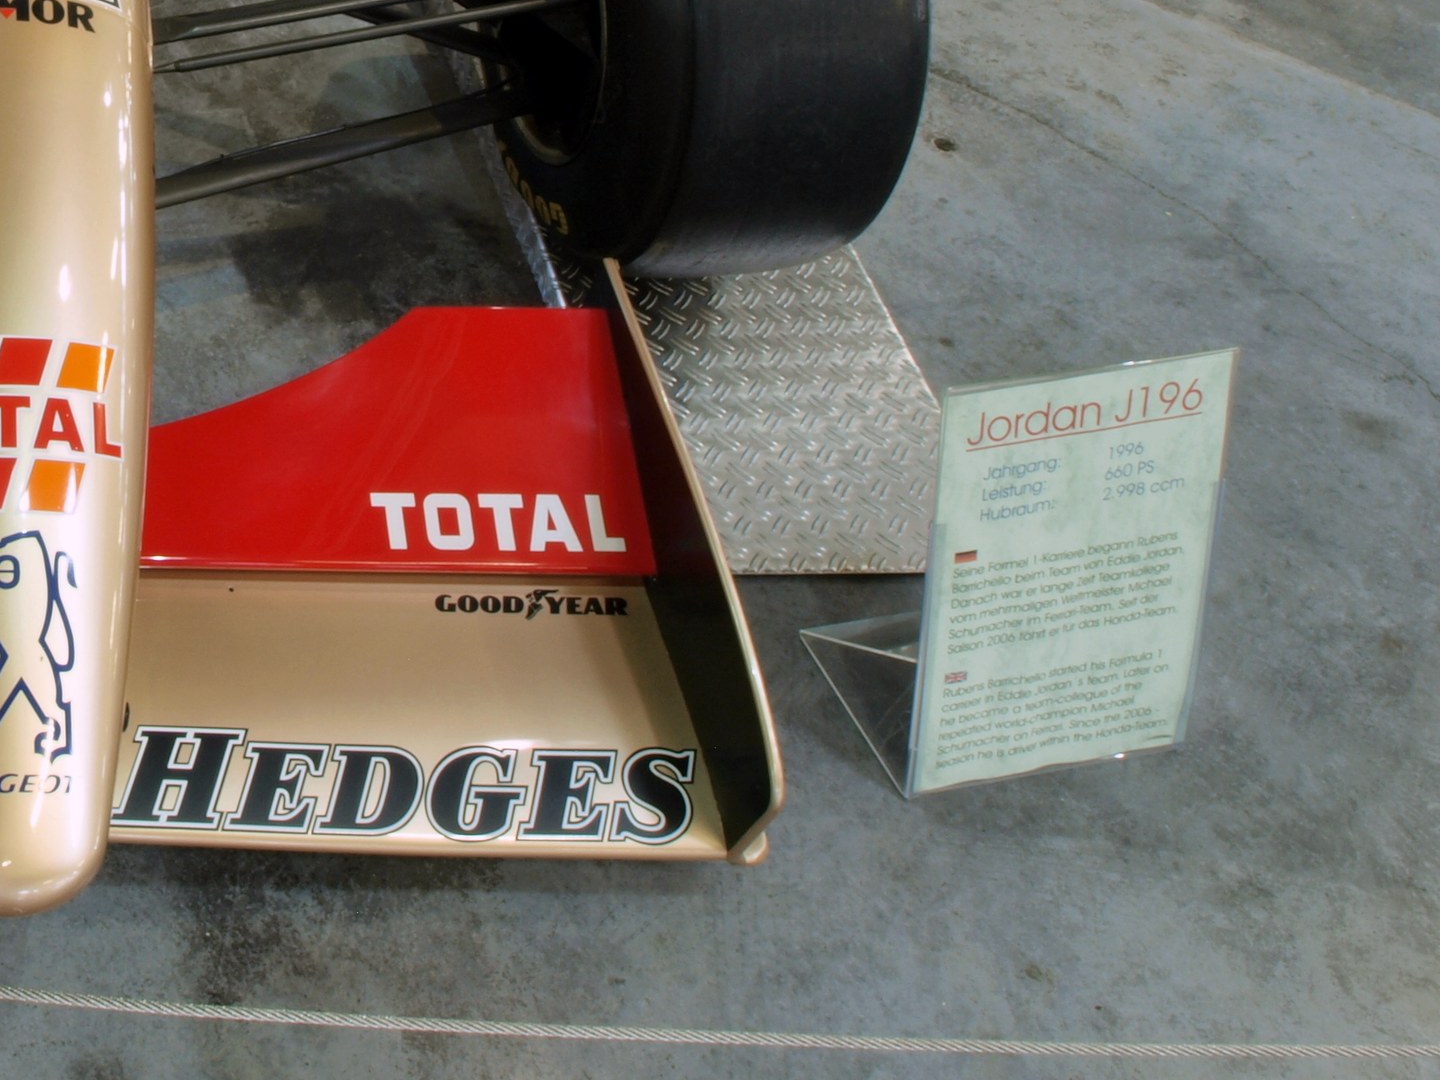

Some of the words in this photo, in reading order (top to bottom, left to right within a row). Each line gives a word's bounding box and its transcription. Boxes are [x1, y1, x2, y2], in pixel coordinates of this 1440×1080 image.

[966, 399, 1103, 445] Jordan
[1114, 377, 1205, 422] J196
[980, 478, 1047, 503] Leistung:
[1104, 463, 1133, 480] 660
[1136, 459, 1155, 474] PS
[982, 455, 1062, 484] Jahrgang:
[1108, 440, 1145, 459] 1996
[369, 492, 627, 553] TOTAL
[979, 497, 1055, 522] Hubraum:
[1102, 481, 1146, 501] 2.998
[1149, 477, 1185, 492] ccm
[111, 725, 697, 845] HEDGES
